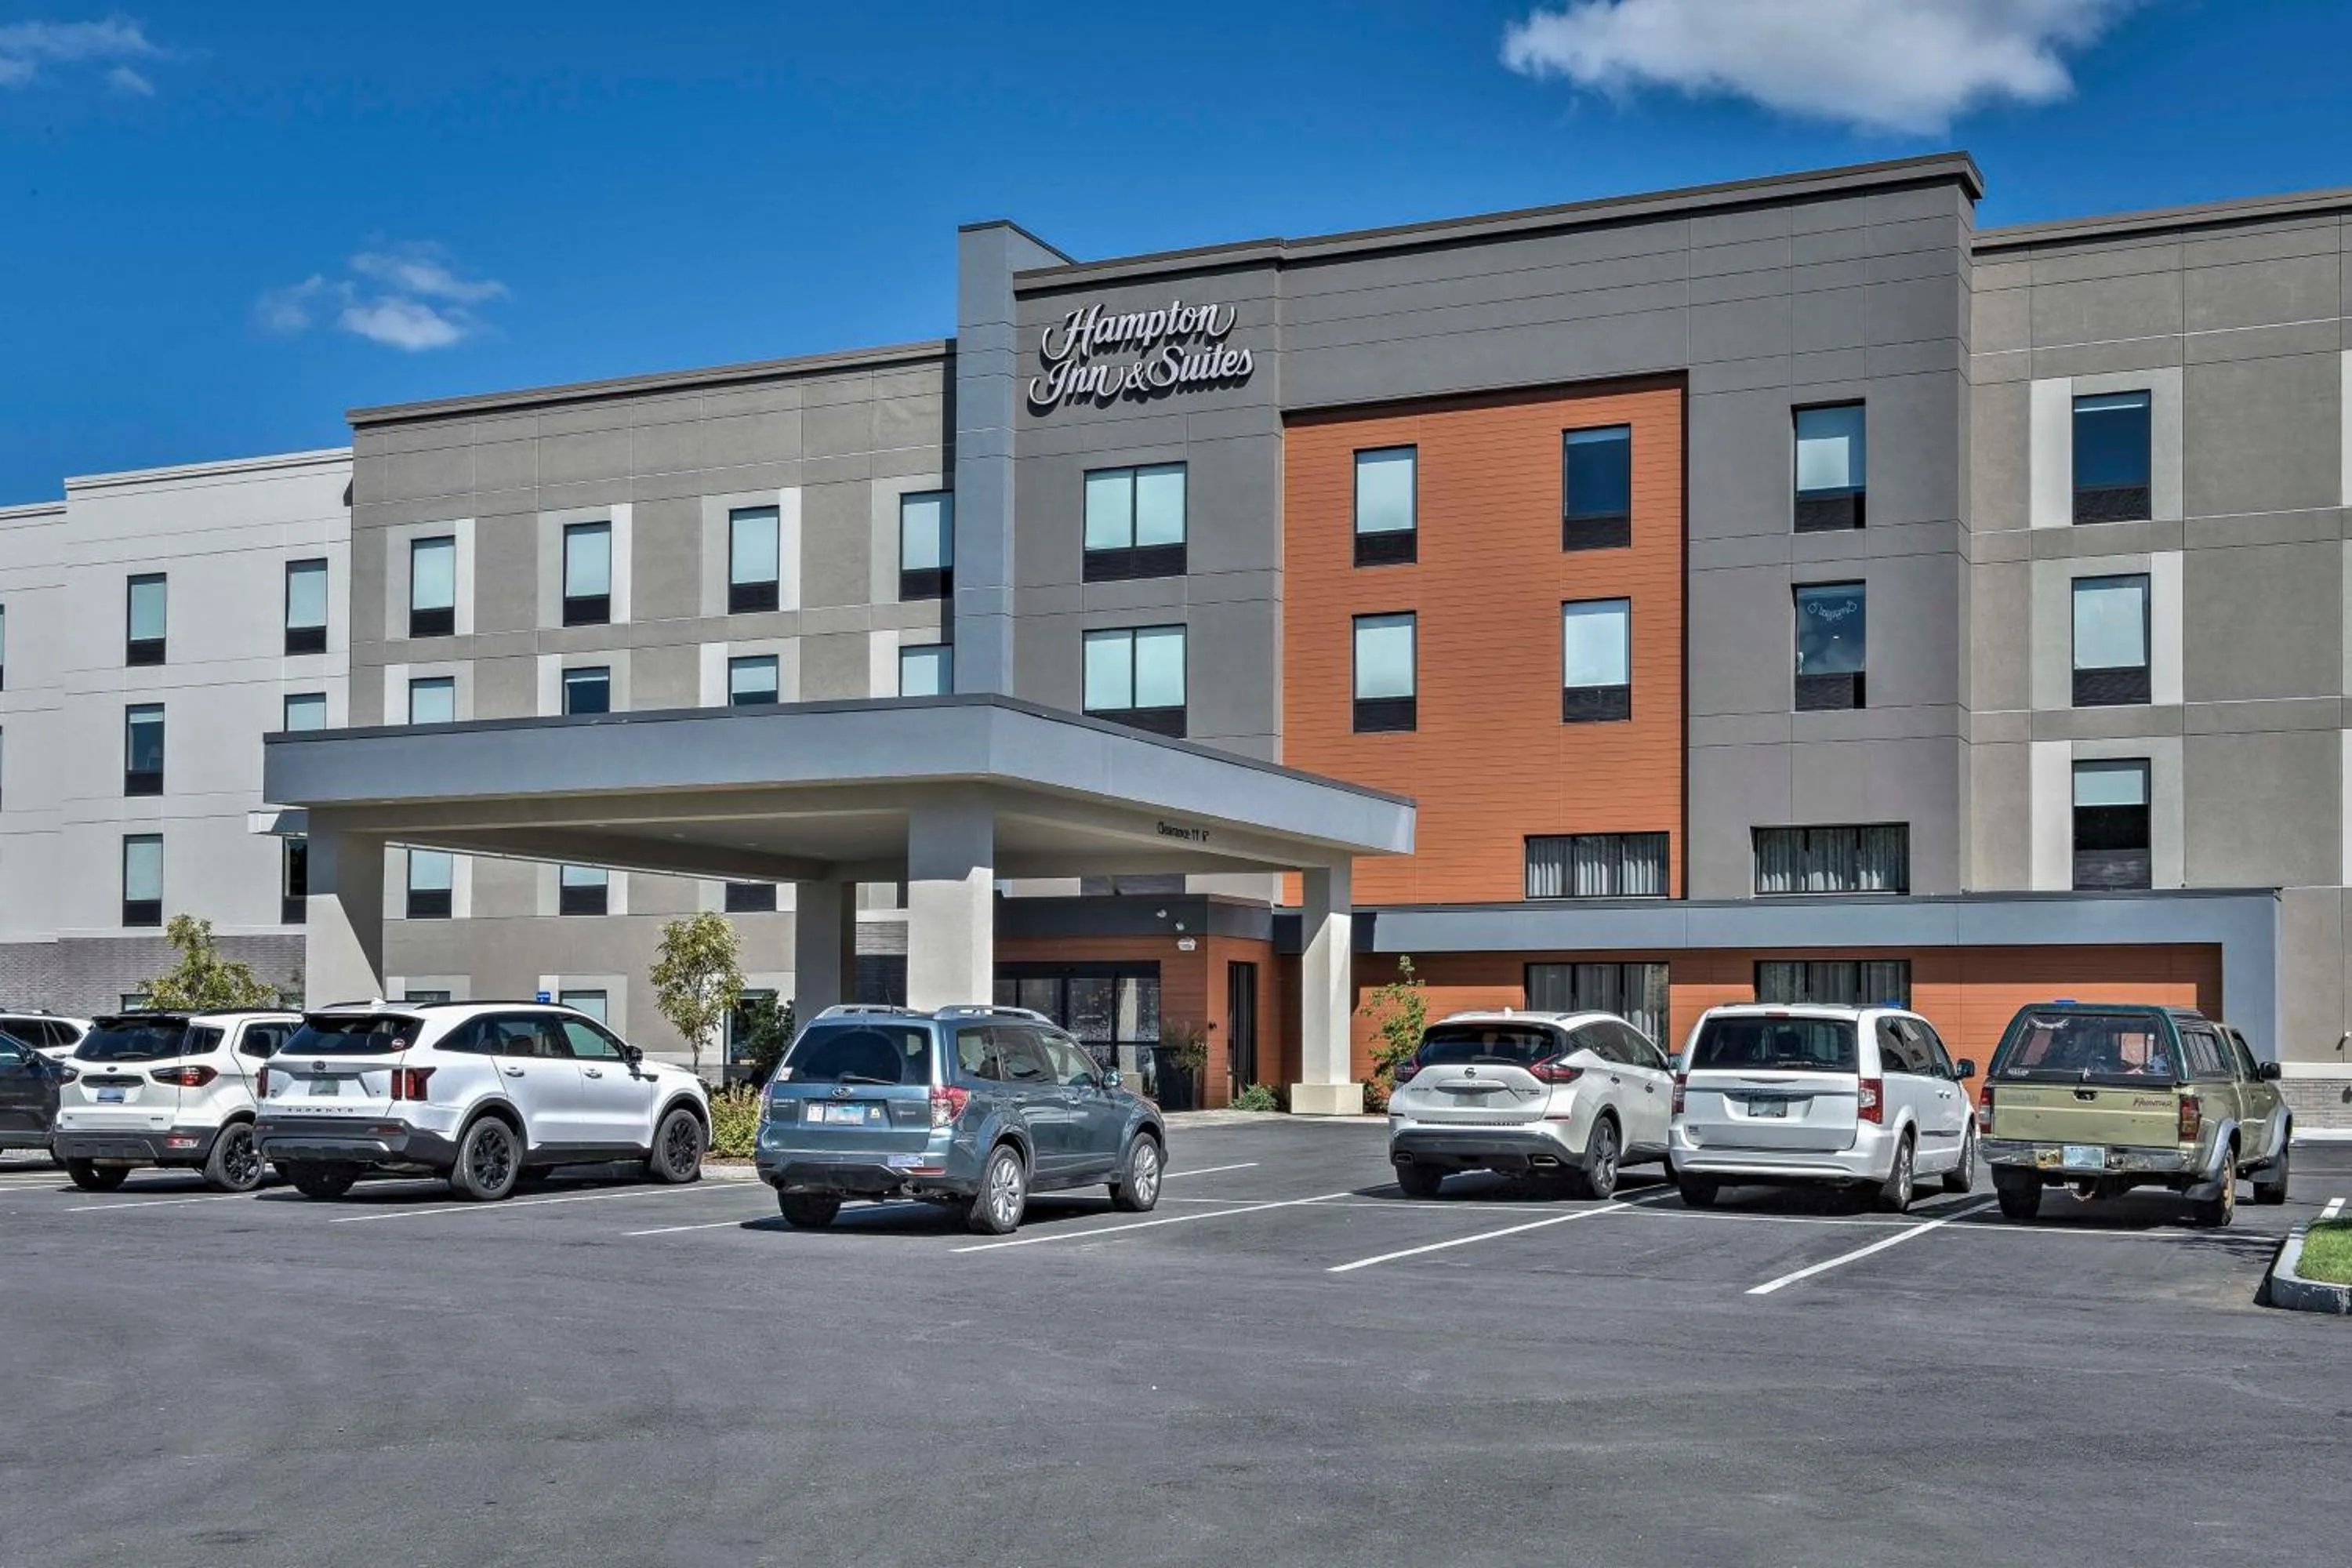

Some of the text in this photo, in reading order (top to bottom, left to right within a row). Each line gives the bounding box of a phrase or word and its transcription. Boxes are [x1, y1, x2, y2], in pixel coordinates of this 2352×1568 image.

[1042, 300, 1236, 361] Hampton
[1029, 346, 1254, 405] Inn & Suites
